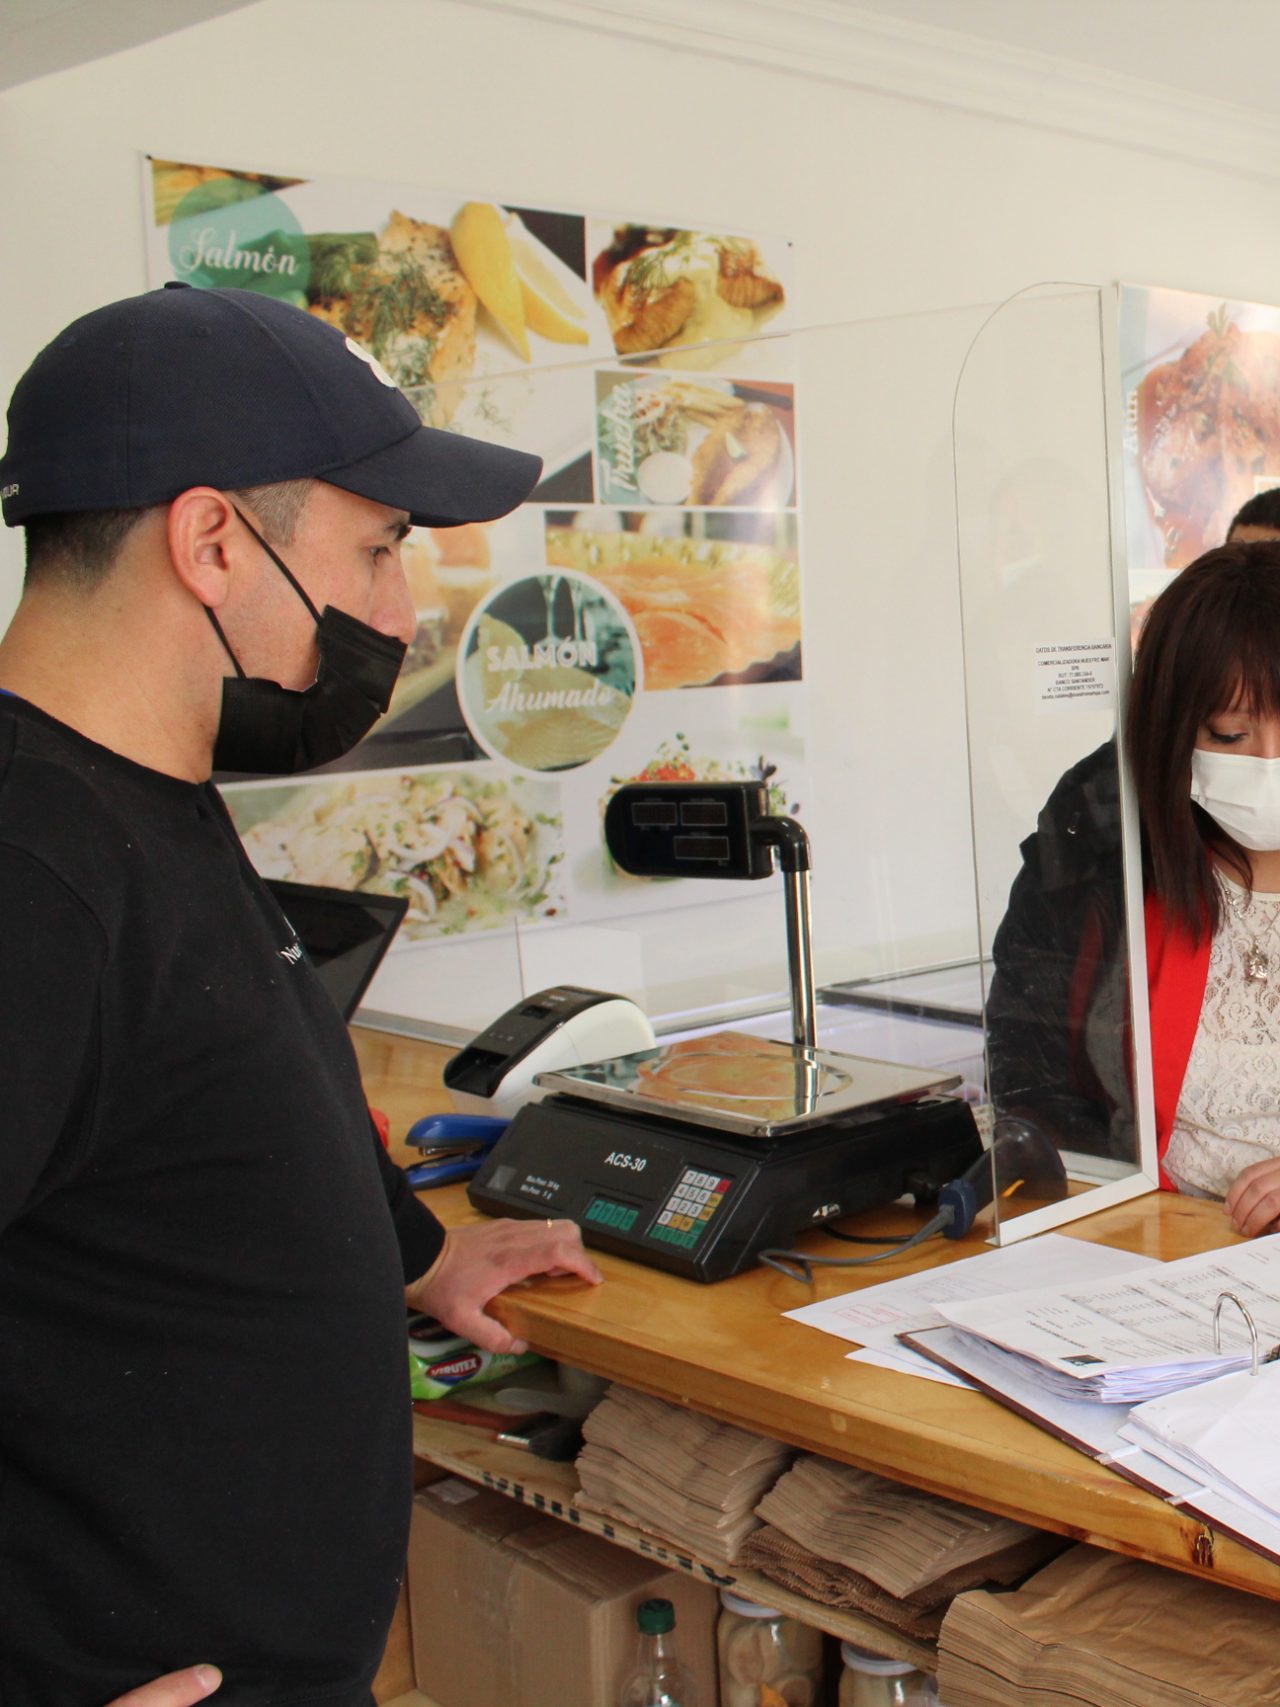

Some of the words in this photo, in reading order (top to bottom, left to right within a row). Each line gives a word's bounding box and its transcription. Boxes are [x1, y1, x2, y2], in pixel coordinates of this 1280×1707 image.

[178, 226, 299, 276] Salmón
[599, 382, 638, 496] Trucha
[486, 635, 598, 673] SALMÓN
[485, 677, 614, 713] Ahumado
[604, 1152, 647, 1172] ACS-30
